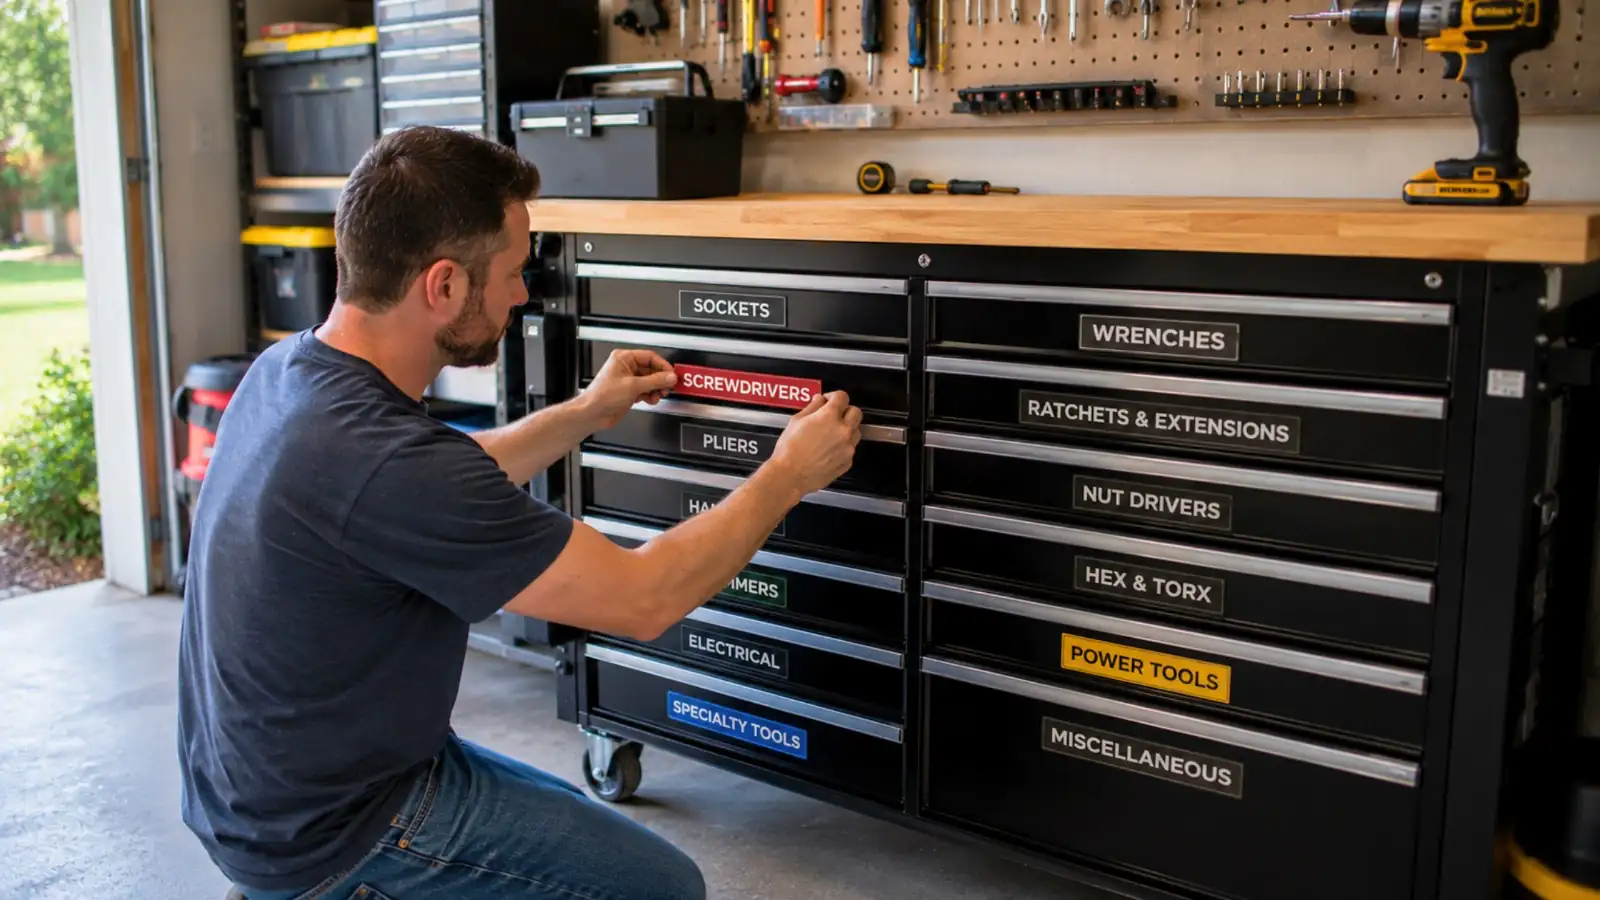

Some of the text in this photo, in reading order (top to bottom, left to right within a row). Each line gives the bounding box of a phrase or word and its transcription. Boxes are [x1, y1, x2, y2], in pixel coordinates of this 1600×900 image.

[693, 298, 769, 319] SOCKETS
[1093, 324, 1224, 350] WRENCHES
[683, 373, 810, 402] SCREWDRIVERS
[1029, 400, 1289, 442] RATCHETS & EXTENSIONS
[704, 434, 758, 454] PLIERS
[1084, 486, 1220, 519] NUT DRIVERS
[1086, 567, 1211, 603] HEX & TORX
[688, 634, 780, 669] ELECTRICAL
[1071, 645, 1219, 691] POWER TOOLS
[673, 700, 800, 749] SPECIALTY TOOLS
[1052, 727, 1231, 786] MISCELLANEOUS
